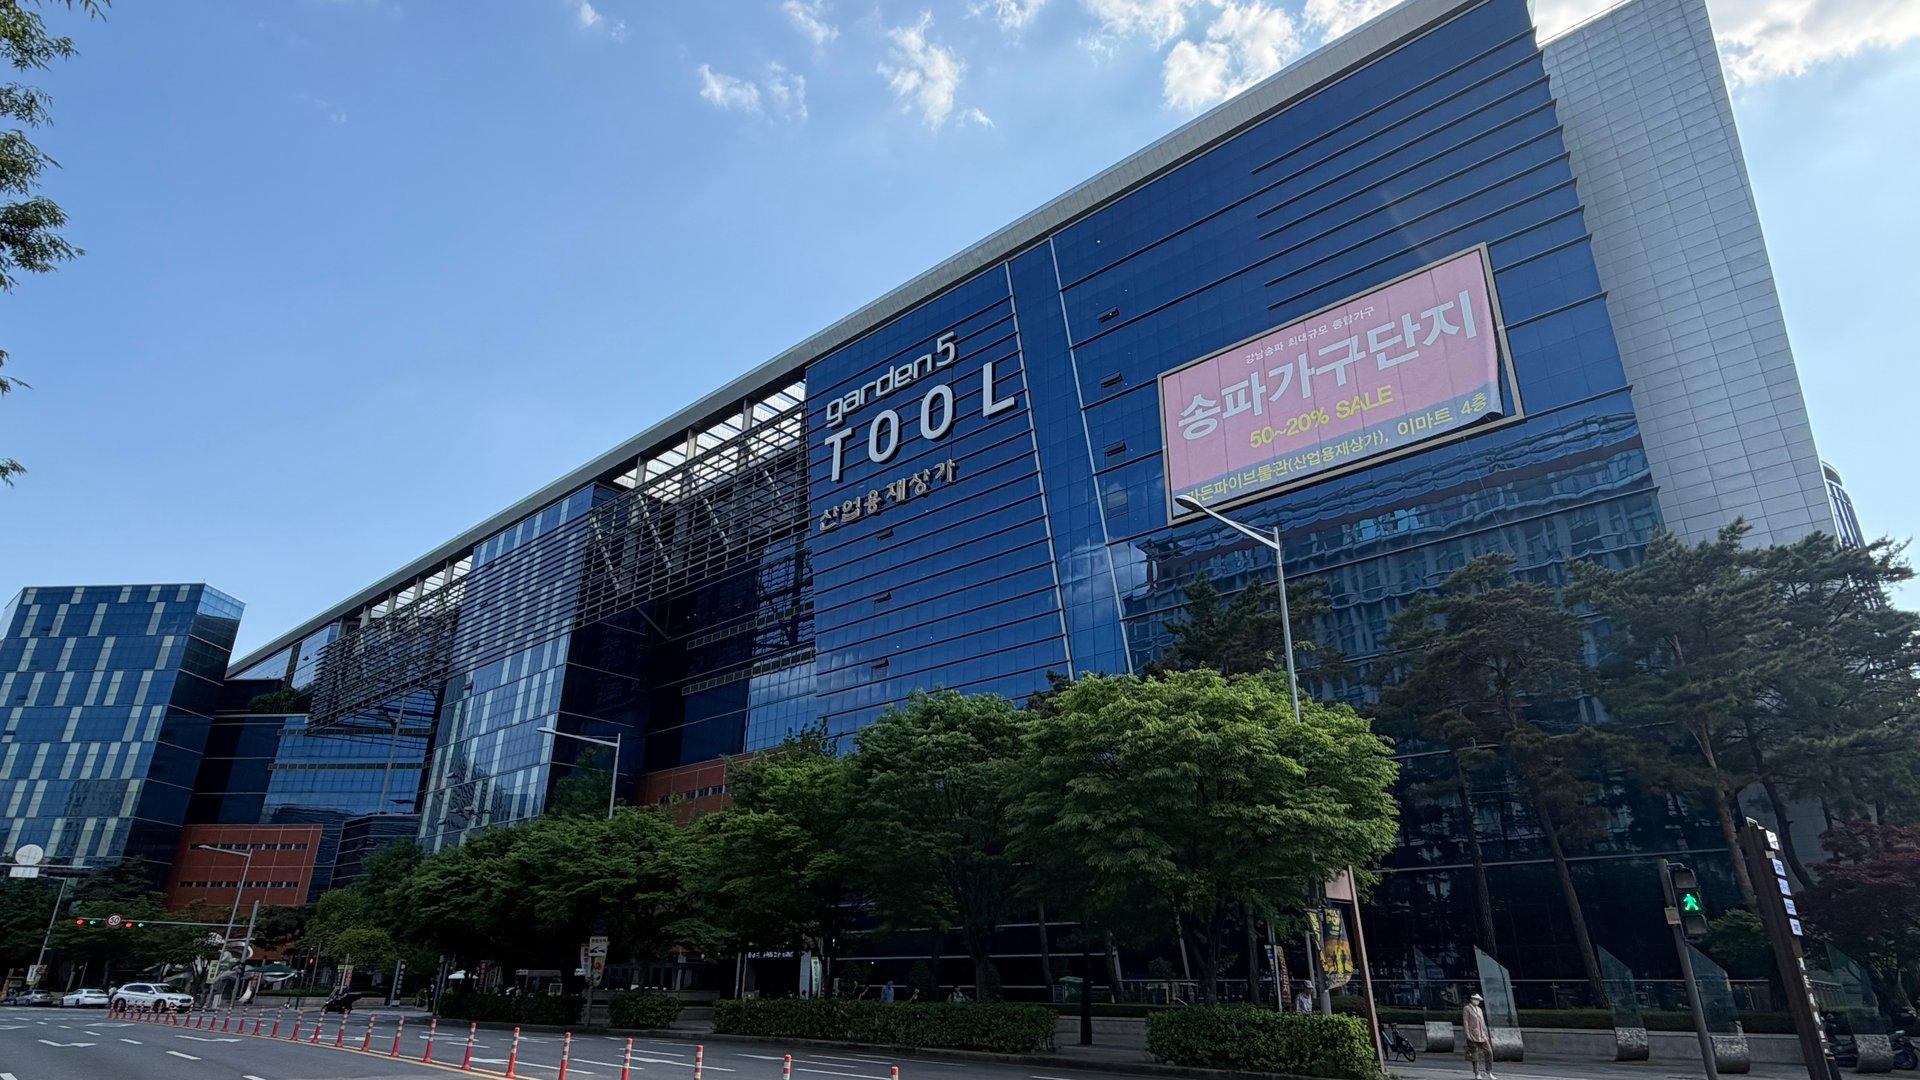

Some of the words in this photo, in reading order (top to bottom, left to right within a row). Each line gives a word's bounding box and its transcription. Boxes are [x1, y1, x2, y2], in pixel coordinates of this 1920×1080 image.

[826, 331, 956, 428] garden5
[1177, 290, 1477, 440] 송파가구단지
[1245, 341, 1284, 365] 강남송파
[1287, 324, 1329, 347] 최대규모
[824, 362, 1015, 482] TOOL
[1250, 406, 1330, 448] 50~20%
[1335, 385, 1394, 419] SALE
[1397, 407, 1453, 436] 이마트
[1461, 392, 1487, 415] 4층
[820, 459, 956, 532] 산업용재상가
